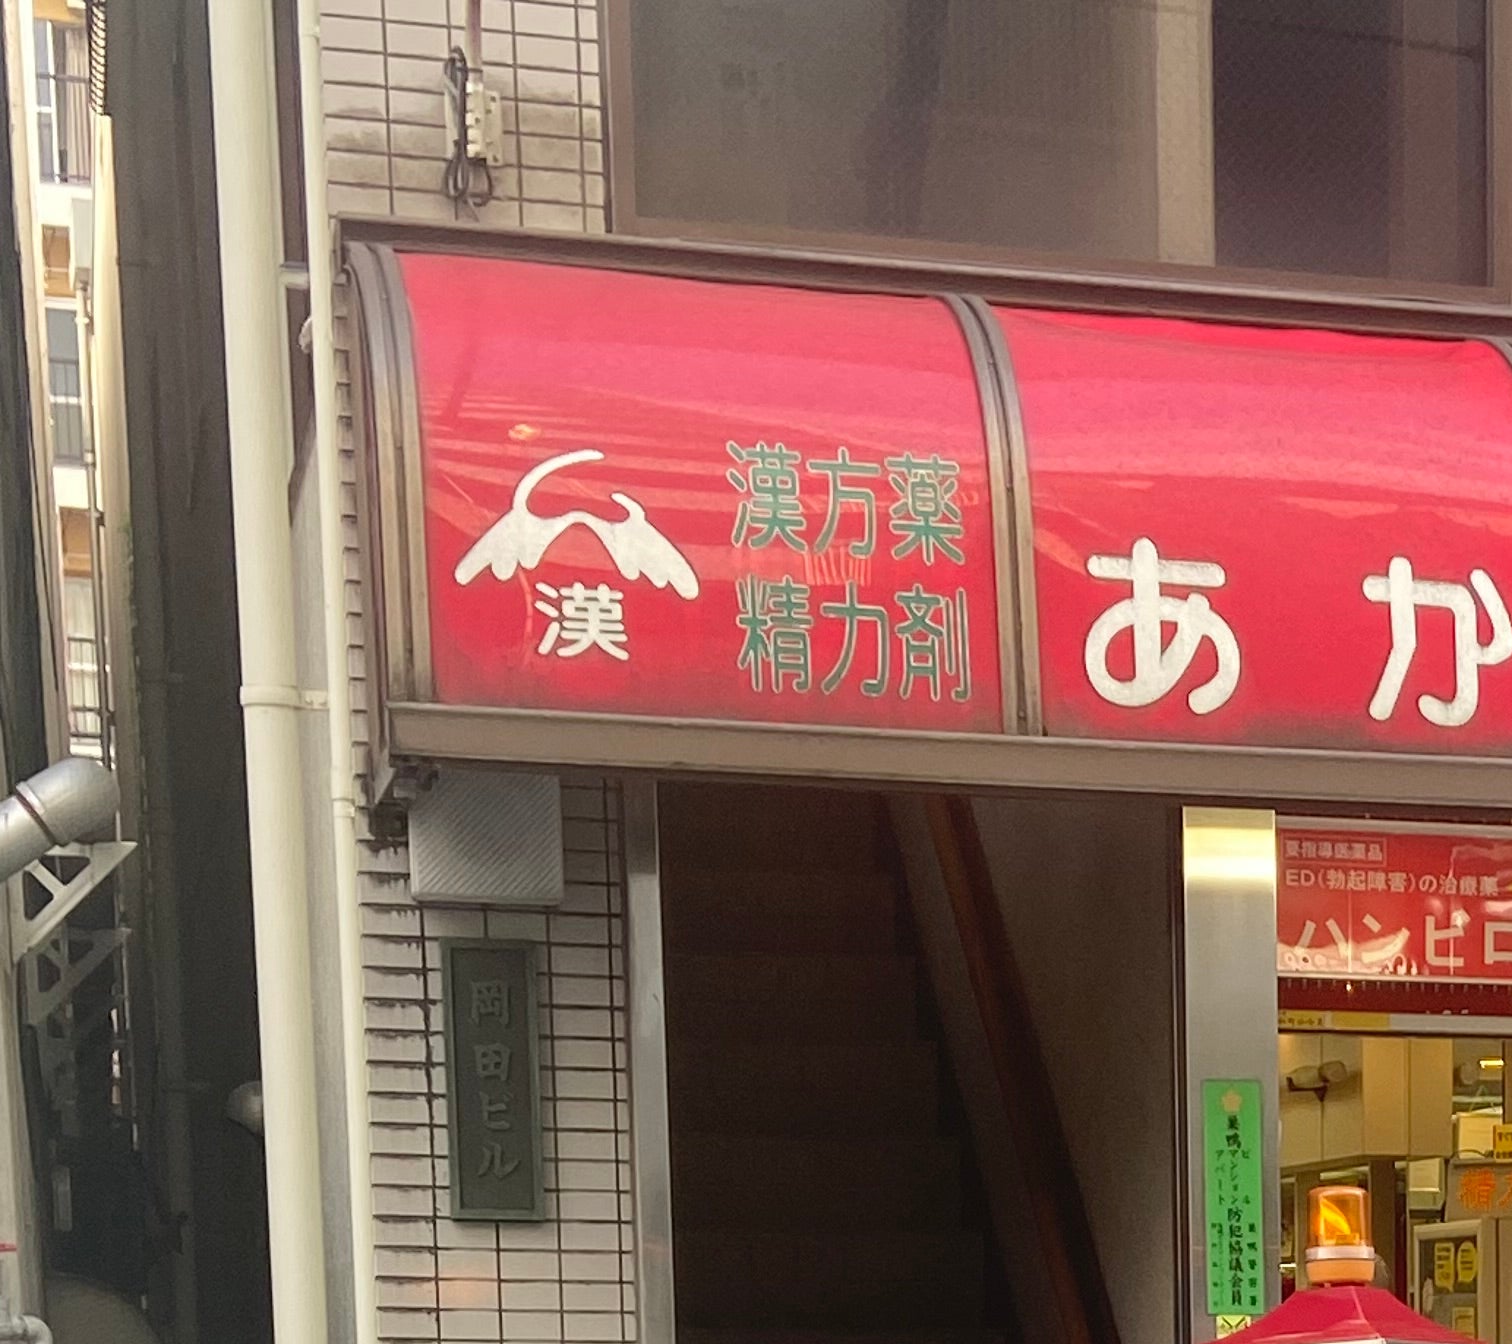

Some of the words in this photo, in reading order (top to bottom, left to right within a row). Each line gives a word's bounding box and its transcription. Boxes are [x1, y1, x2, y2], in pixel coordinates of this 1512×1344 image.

[724, 440, 966, 566] 漢方薬
[533, 580, 630, 662] 漢
[736, 572, 973, 702] 精力剤
[470, 978, 521, 1181] 岡田ビル
